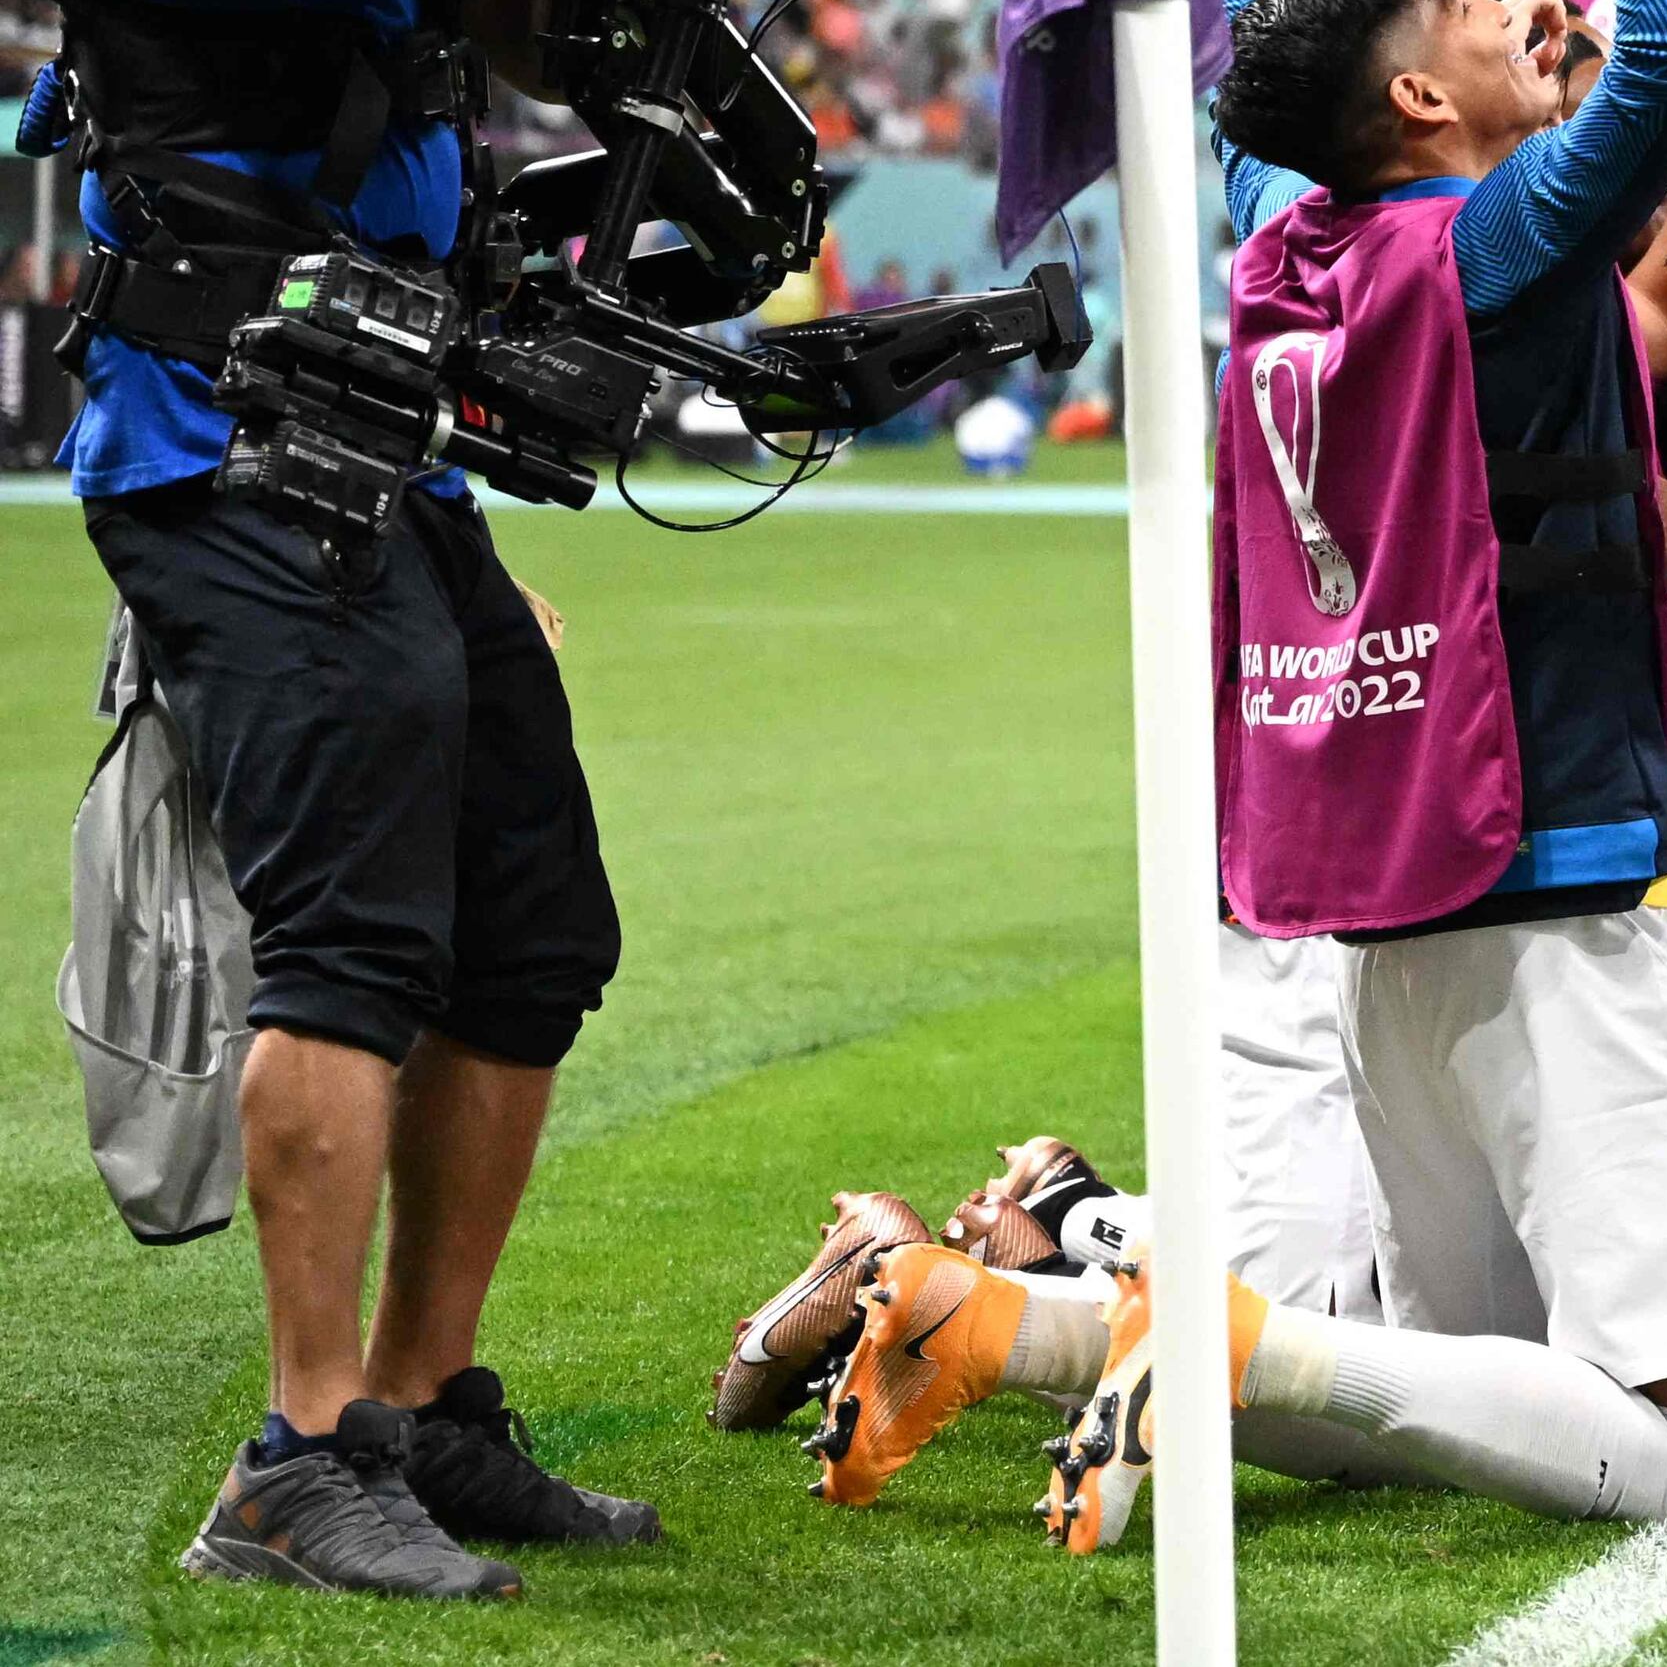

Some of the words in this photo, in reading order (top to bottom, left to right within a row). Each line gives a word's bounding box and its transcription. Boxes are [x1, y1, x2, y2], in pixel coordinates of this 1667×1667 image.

[540, 354, 581, 376] PRO
[1269, 638, 1356, 680] WORLD
[1358, 622, 1440, 667] CUP
